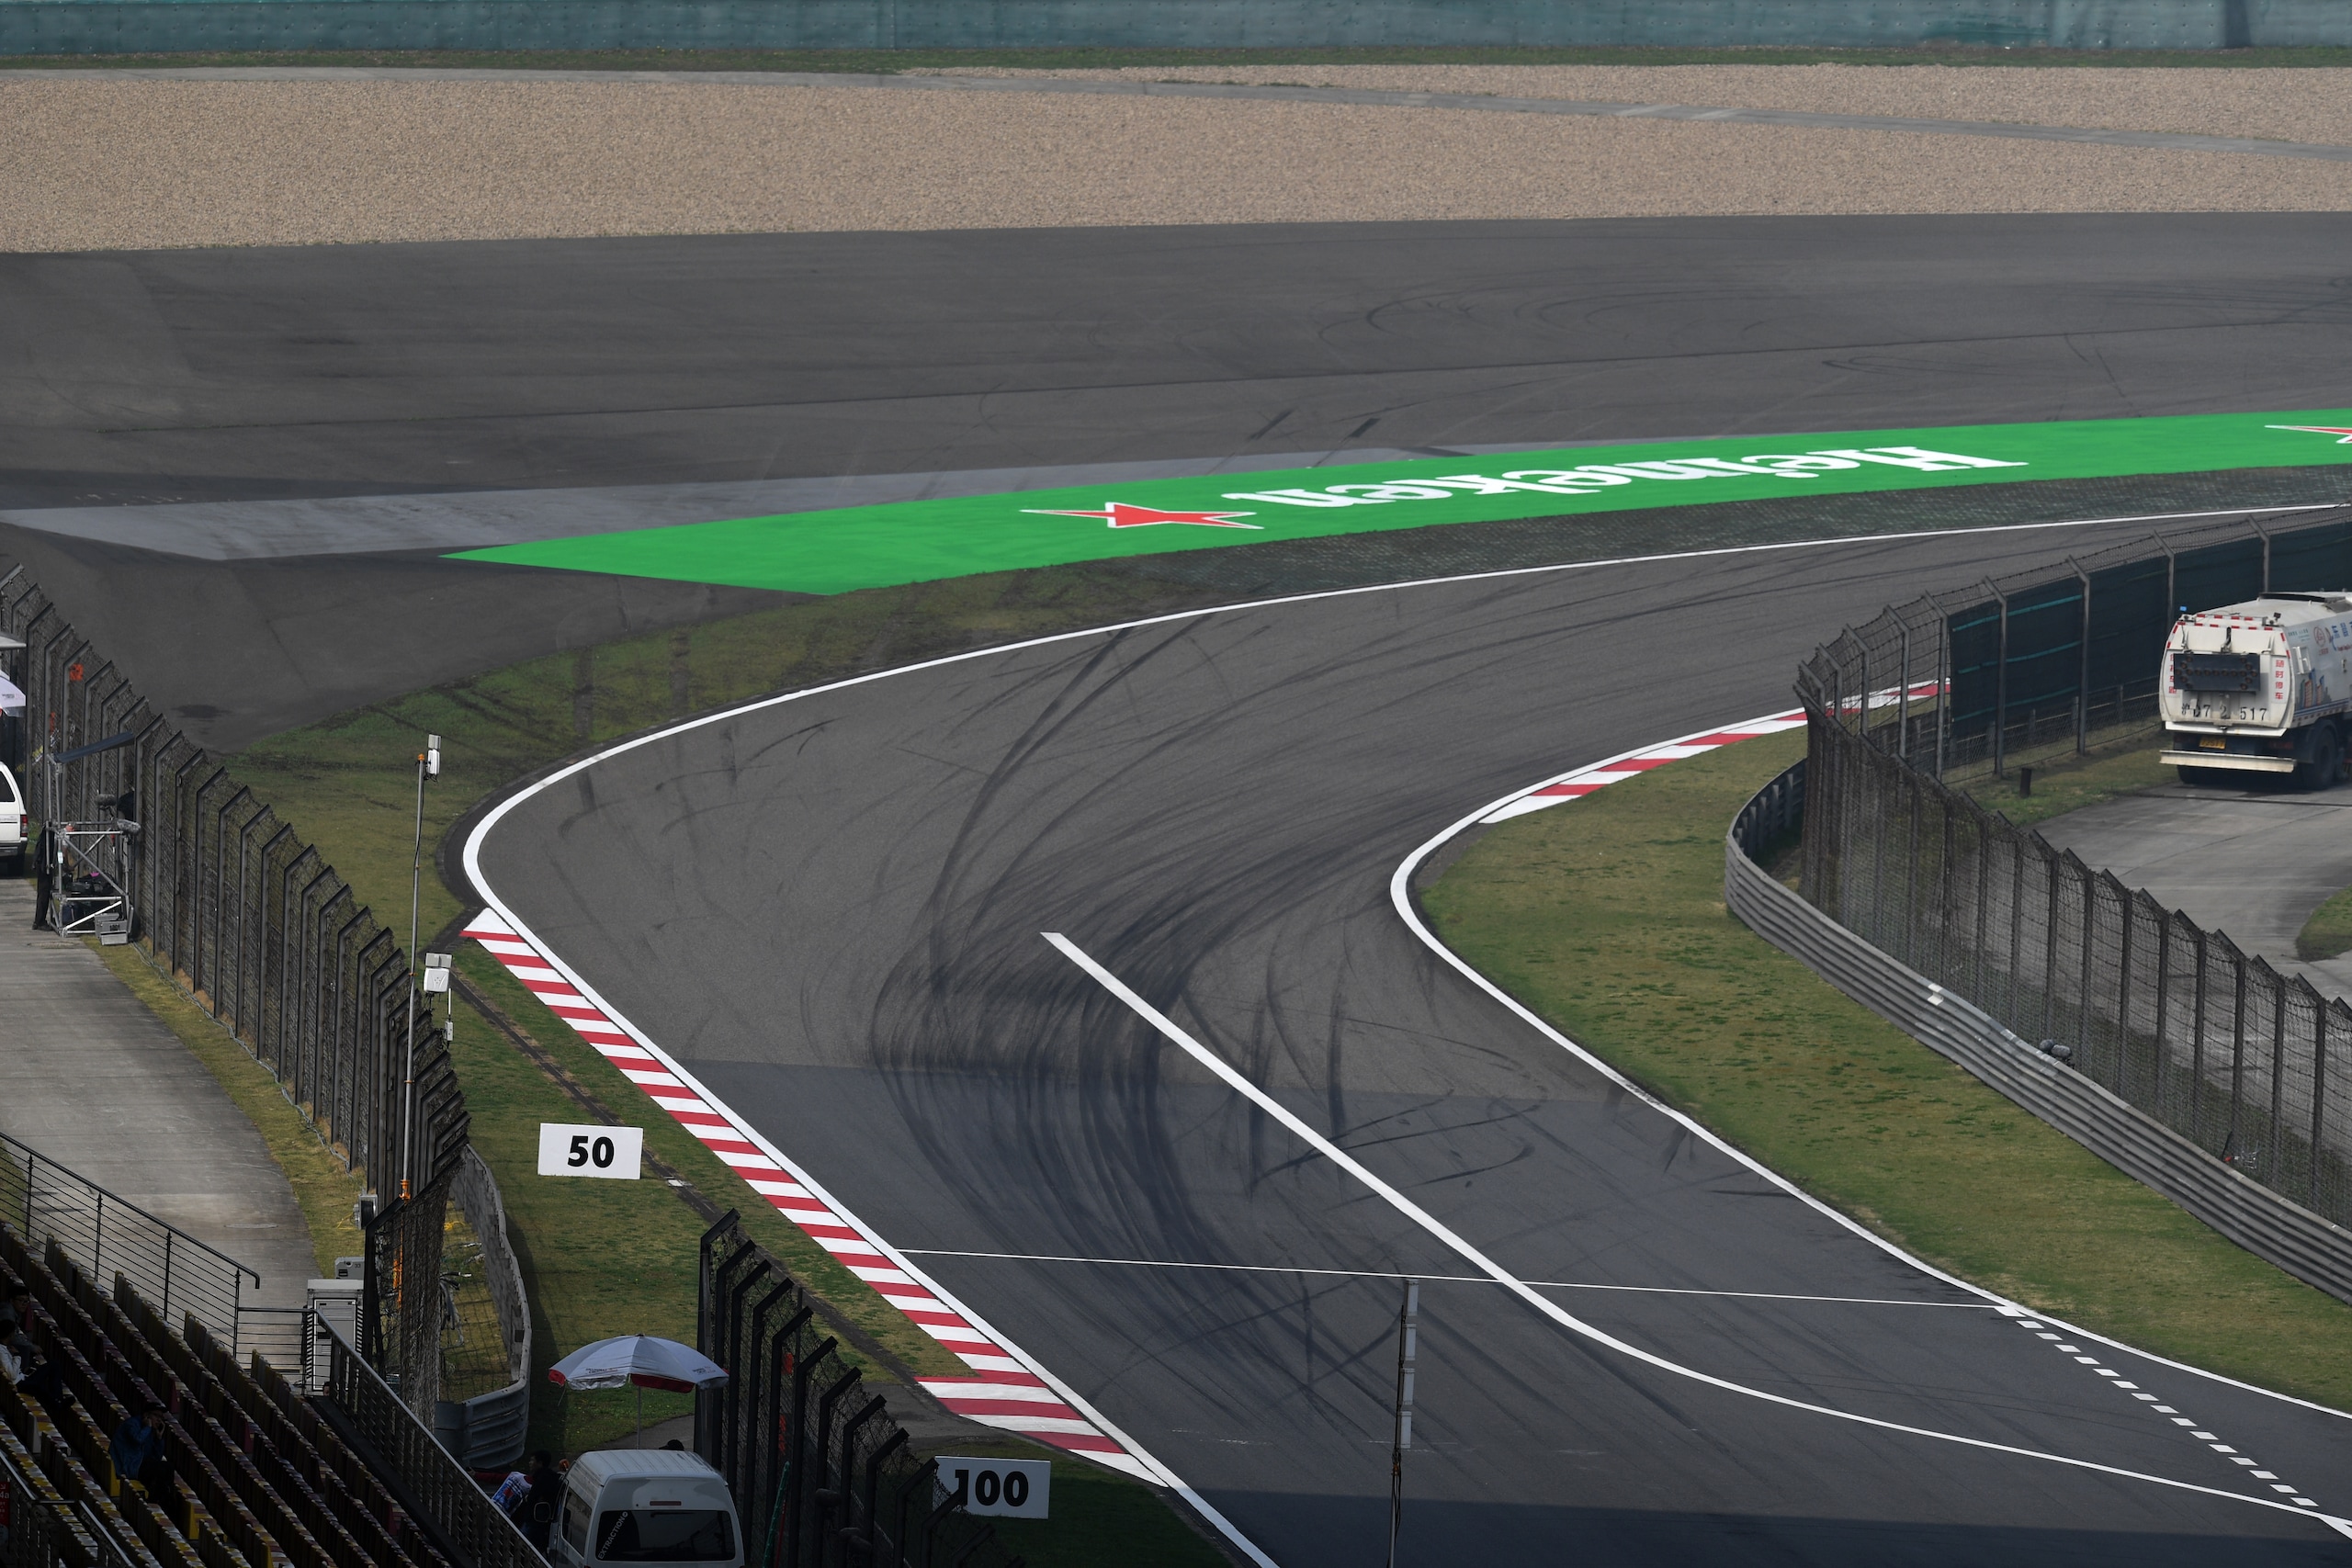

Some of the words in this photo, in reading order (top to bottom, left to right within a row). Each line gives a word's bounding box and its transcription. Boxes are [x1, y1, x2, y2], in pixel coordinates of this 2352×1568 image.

[1222, 446, 2028, 508] Heineken
[567, 1134, 615, 1168] 50
[955, 1469, 1029, 1506] 100
